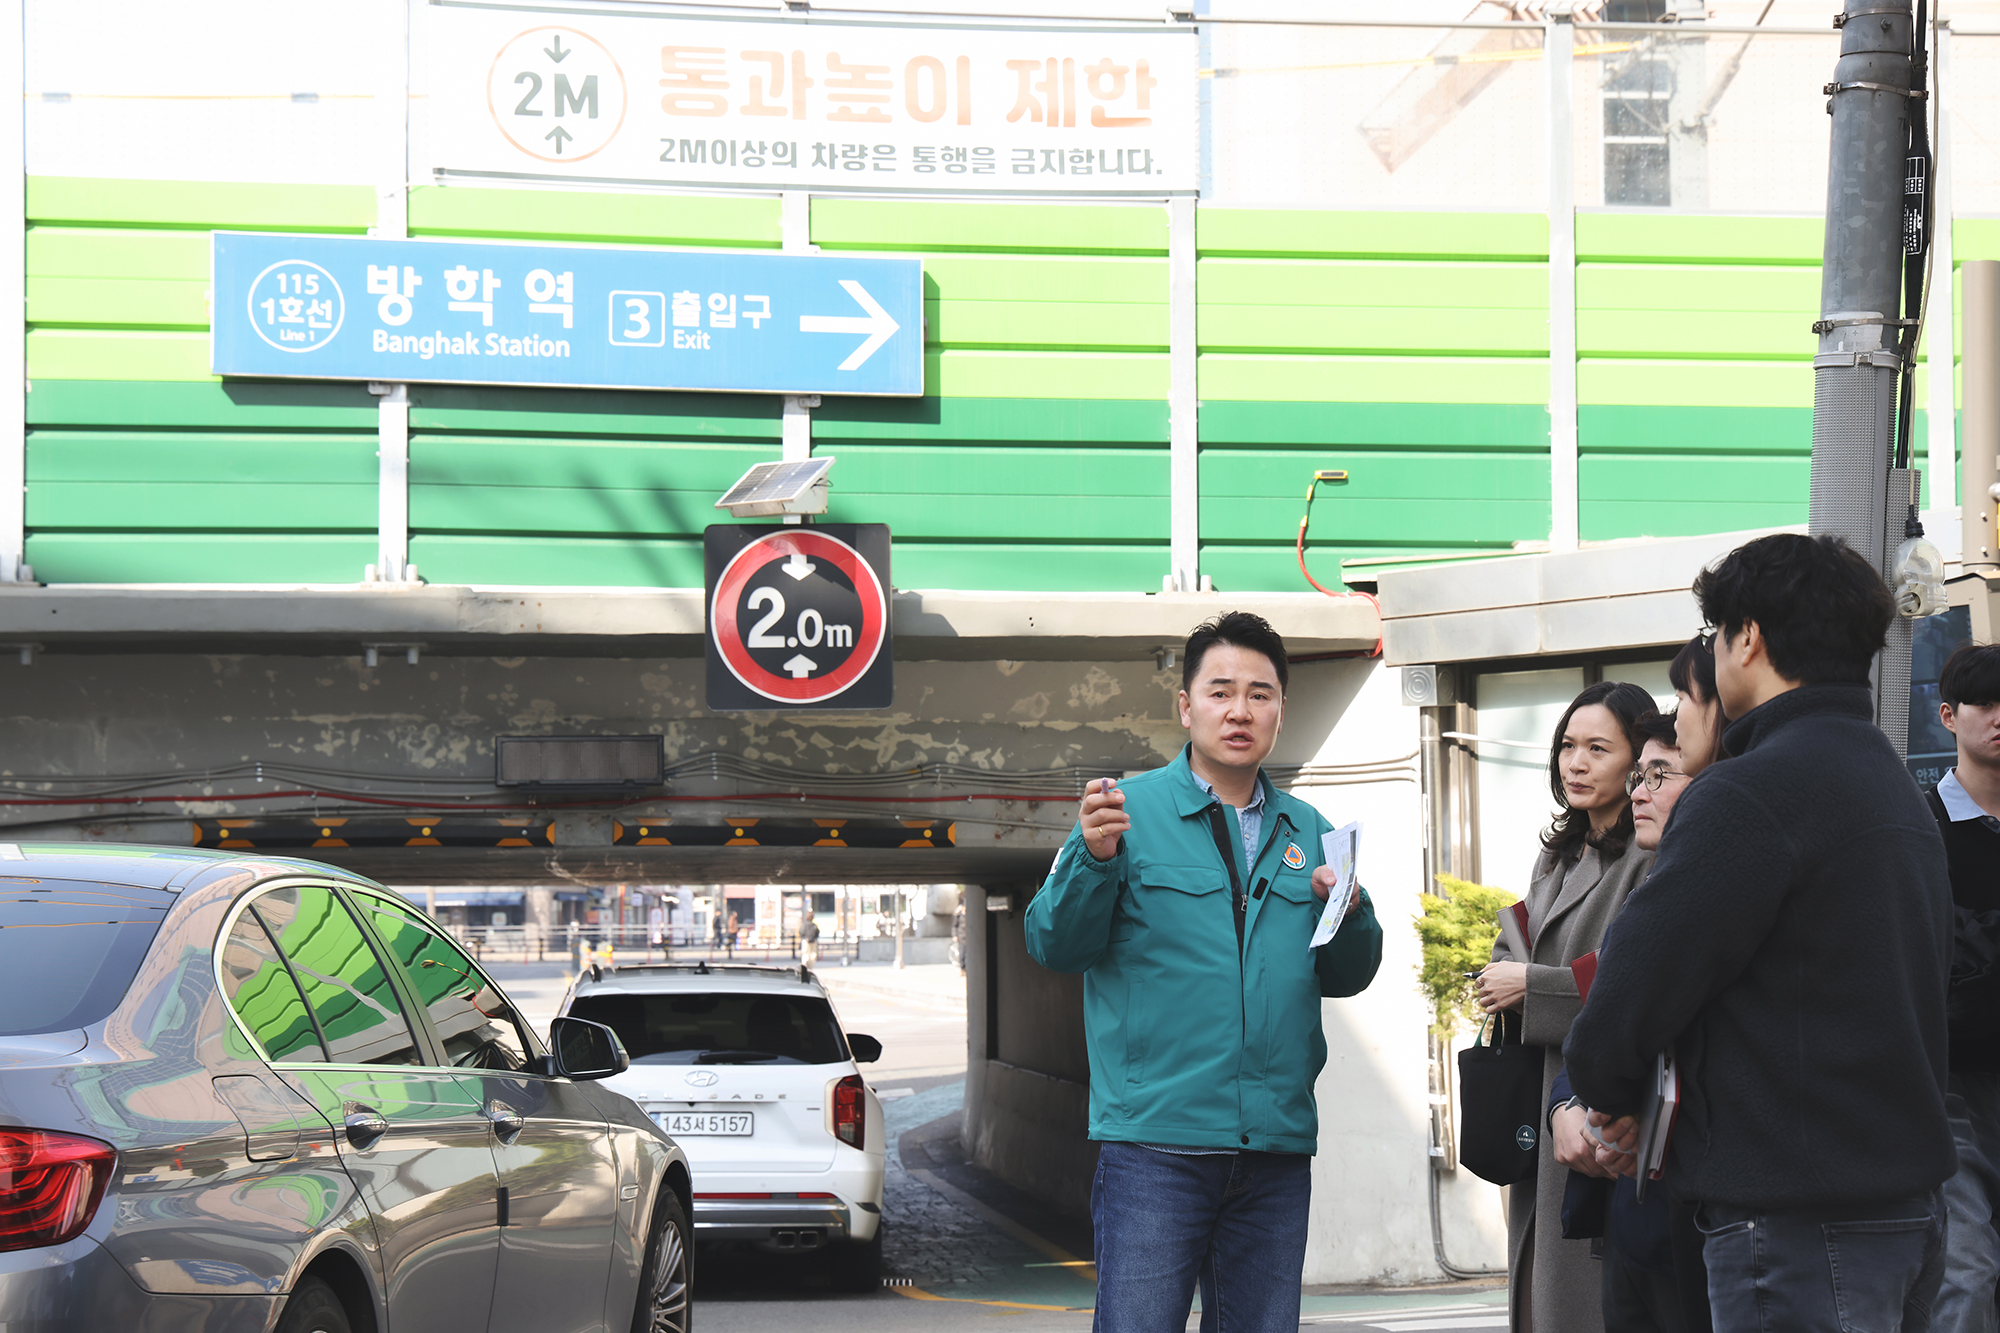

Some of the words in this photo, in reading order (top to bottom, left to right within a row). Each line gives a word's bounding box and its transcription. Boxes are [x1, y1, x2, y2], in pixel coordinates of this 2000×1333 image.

[513, 70, 600, 120] 2M
[658, 44, 973, 127] 통과높이
[1004, 55, 1157, 129] 제한
[658, 136, 798, 170] 2M이상의
[811, 142, 898, 174] 차량은
[911, 144, 998, 175] 통행을
[1010, 147, 1164, 177] 금지합니다.
[275, 272, 319, 296] 115
[259, 298, 335, 330] 1호선
[623, 297, 651, 340] 3
[670, 289, 772, 331] 출입구
[279, 328, 307, 342] Line
[308, 329, 316, 342] 1
[371, 328, 480, 359] Banghak
[484, 331, 571, 358] Station
[672, 328, 711, 351] Exit
[747, 585, 853, 649] 2.0m
[1916, 767, 1940, 784] 안전
